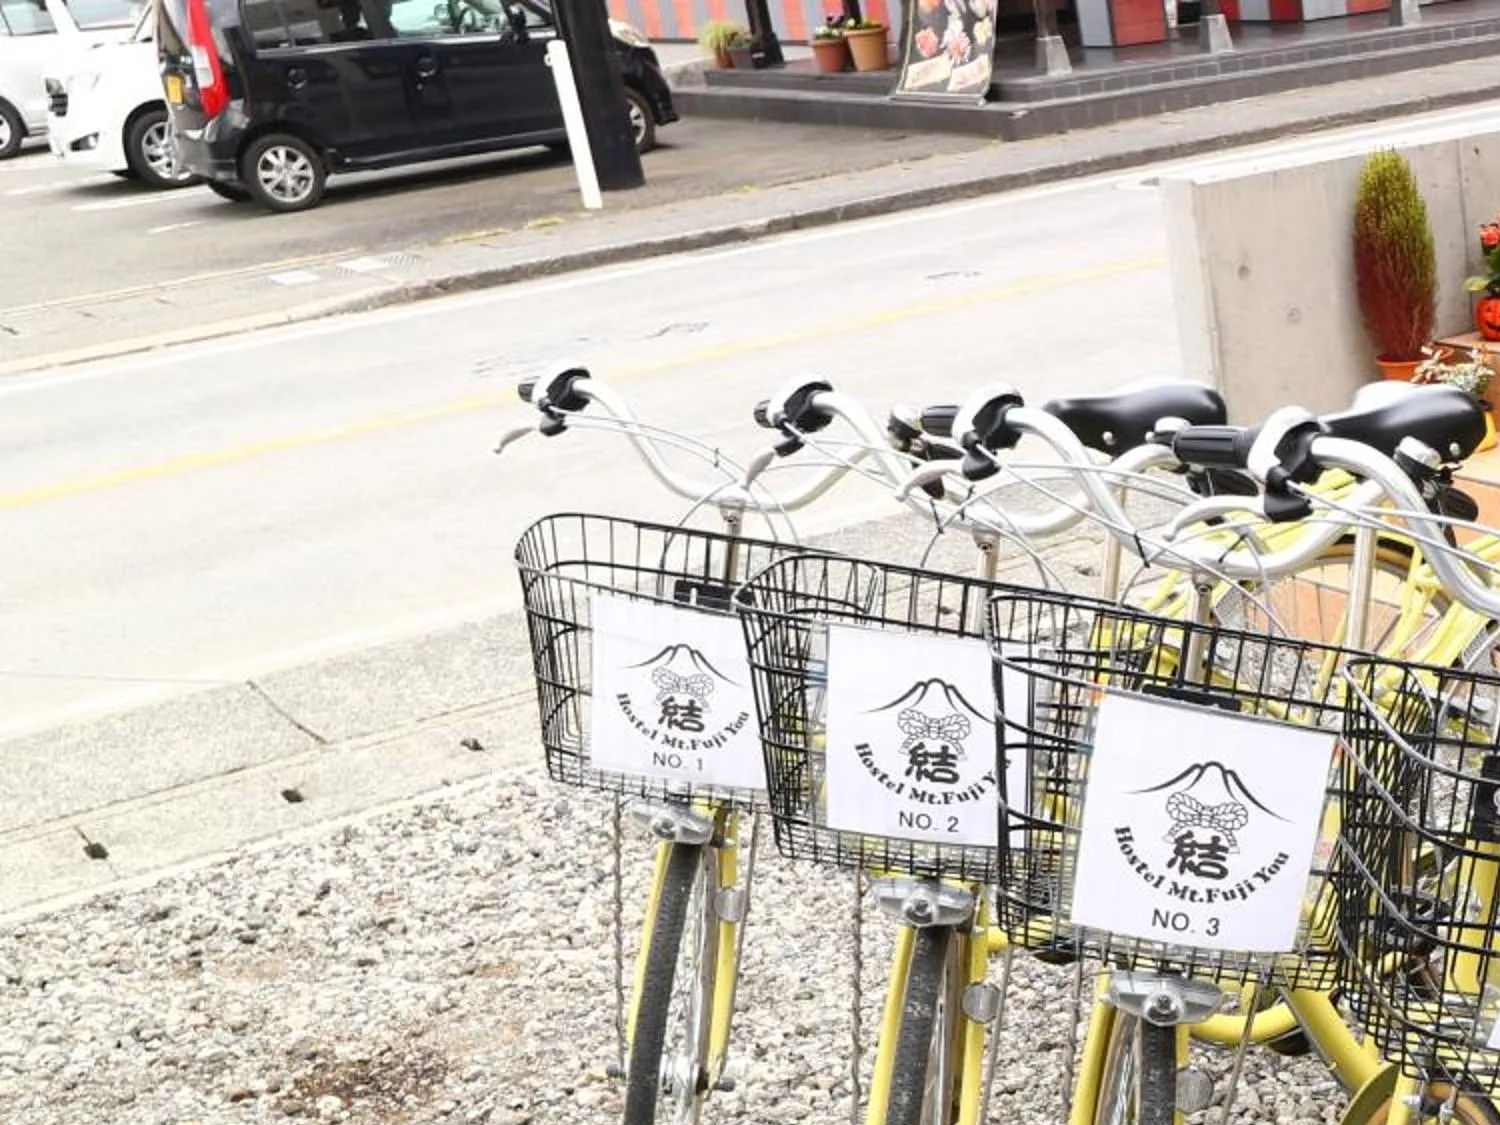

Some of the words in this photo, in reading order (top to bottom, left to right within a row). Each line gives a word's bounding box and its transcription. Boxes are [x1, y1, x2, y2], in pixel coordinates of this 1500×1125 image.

[616, 693, 658, 740] Hostel
[724, 711, 750, 735] You
[696, 757, 703, 771] 1
[855, 743, 905, 794] Hostel
[899, 811, 939, 831] NO.
[947, 816, 959, 832] 2
[1114, 826, 1165, 889] Hostel
[1253, 851, 1290, 884] You
[1152, 909, 1196, 933] NO.
[1205, 918, 1220, 937] 3
